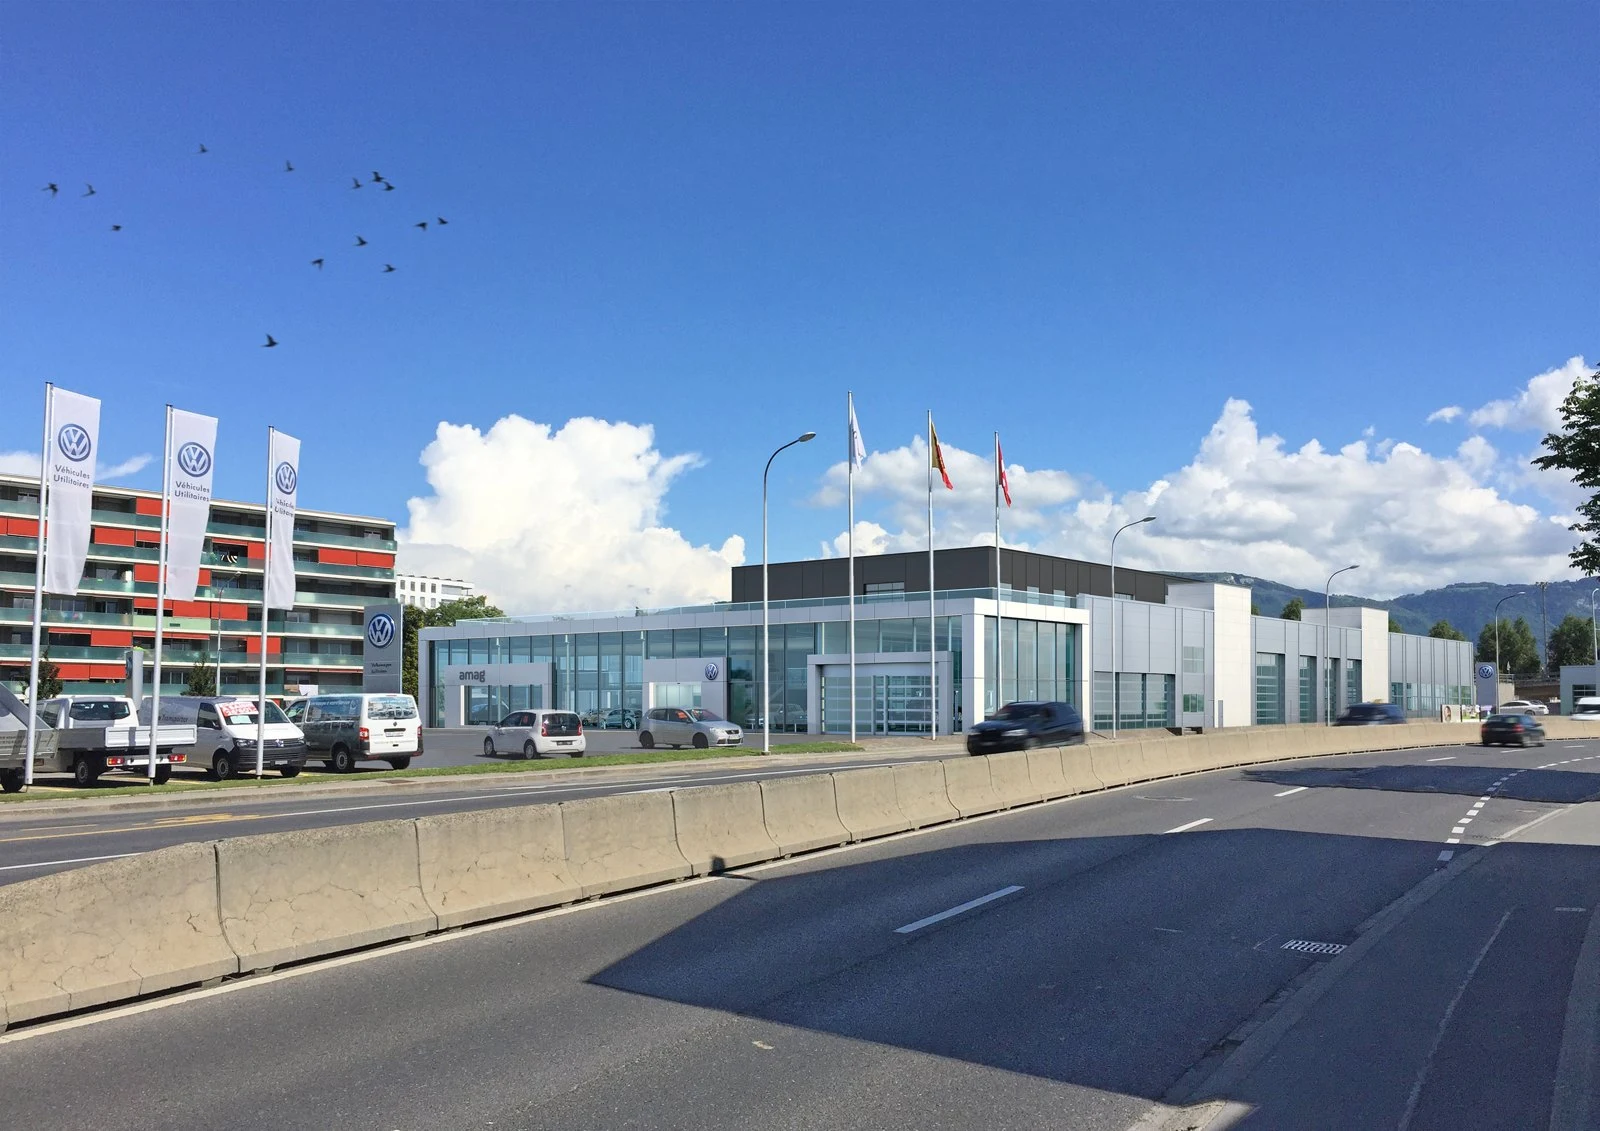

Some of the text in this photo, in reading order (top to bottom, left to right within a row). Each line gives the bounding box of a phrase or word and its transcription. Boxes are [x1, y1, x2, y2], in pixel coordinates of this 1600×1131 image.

[54, 464, 91, 480] Véhicules
[53, 474, 90, 489] Utilitaires
[175, 480, 210, 494] Véhicules
[174, 489, 210, 502] Utilitaires
[459, 670, 486, 683] amag
